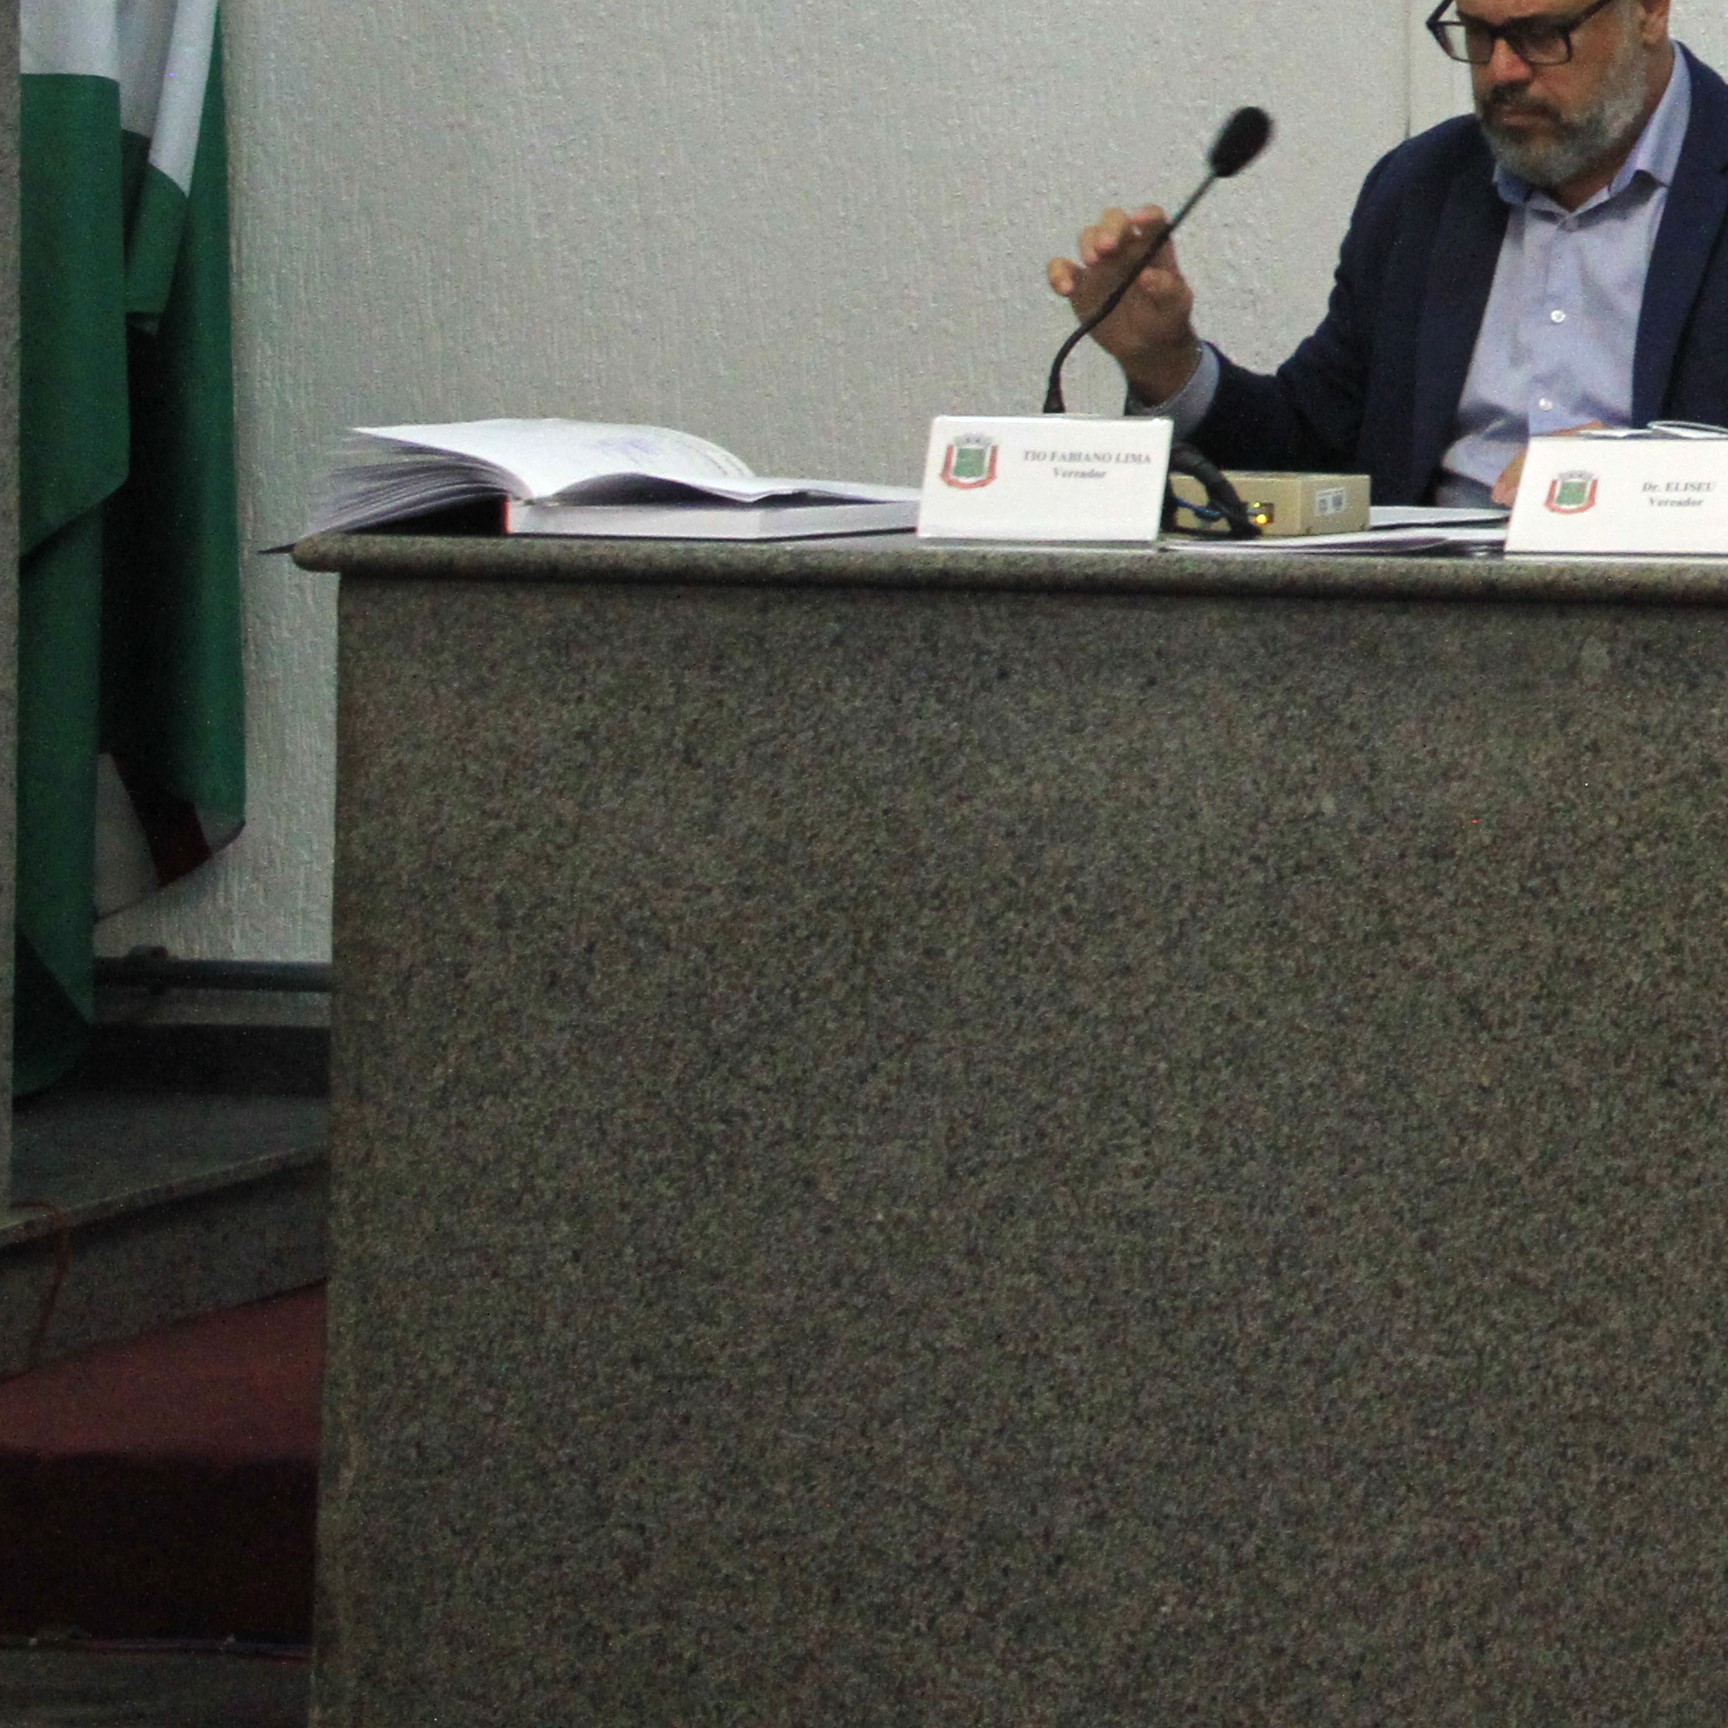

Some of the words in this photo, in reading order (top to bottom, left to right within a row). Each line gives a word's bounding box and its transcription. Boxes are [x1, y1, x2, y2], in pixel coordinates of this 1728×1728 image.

[1049, 450, 1112, 464] FABIANO
[1115, 451, 1152, 464] LIMA
[1052, 467, 1107, 479] Vereador
[1664, 481, 1716, 493] ELISEU
[1649, 496, 1704, 508] Vereador
